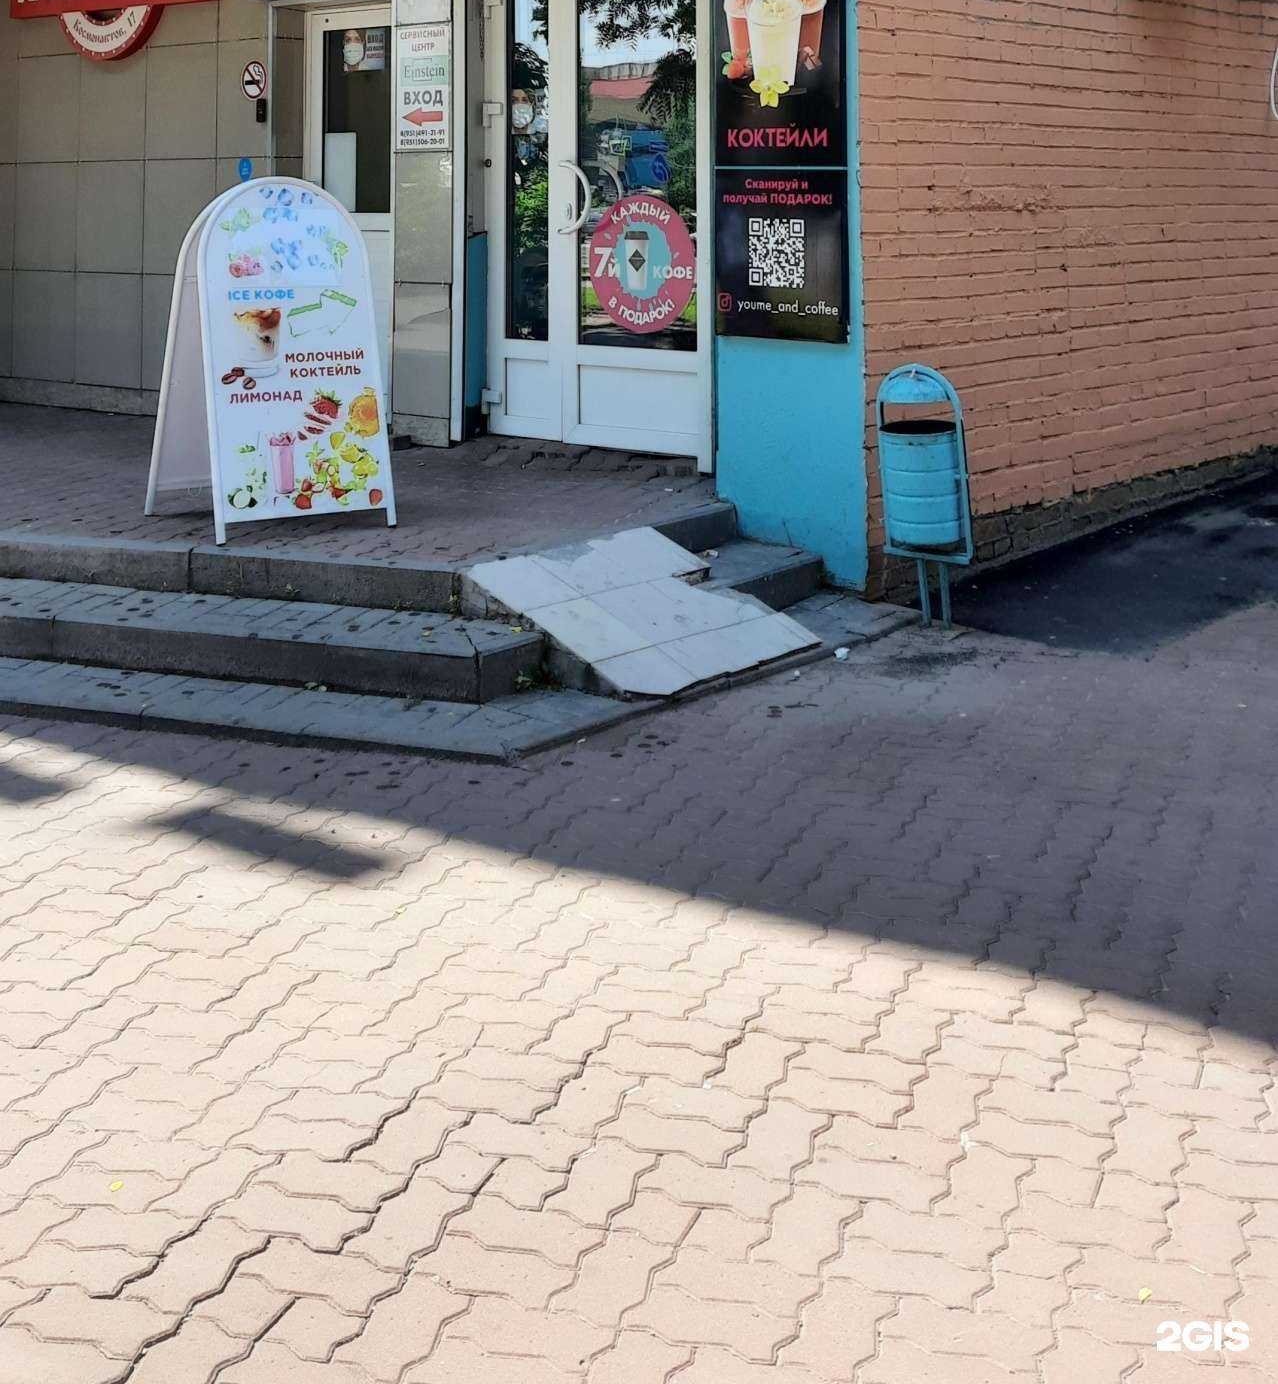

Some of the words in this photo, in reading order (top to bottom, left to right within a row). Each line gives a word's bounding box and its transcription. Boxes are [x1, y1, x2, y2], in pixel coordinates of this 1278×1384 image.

[400, 28, 445, 40] СЕРВИСНЫЙ
[411, 42, 435, 52] ЦЕНТР
[404, 64, 445, 79] Einstein
[403, 89, 444, 106] ВХОД
[727, 123, 830, 148] КОКТЕЙЛИ
[745, 178, 799, 191] Сканируй
[801, 181, 808, 189] и
[723, 193, 767, 204] получай
[770, 194, 833, 205] ПОДАРОК!
[611, 202, 671, 225] КАЖДЫЙ
[653, 266, 693, 280] КОФЕ
[228, 290, 250, 301] ICE
[254, 289, 295, 300] КОФЕ
[737, 300, 839, 316] youme_and_coffee
[285, 348, 364, 364] МОЛОЧНЫЙ
[290, 364, 361, 378] КОКТЕЙЛЬ
[230, 391, 303, 404] ЛИМОНАД
